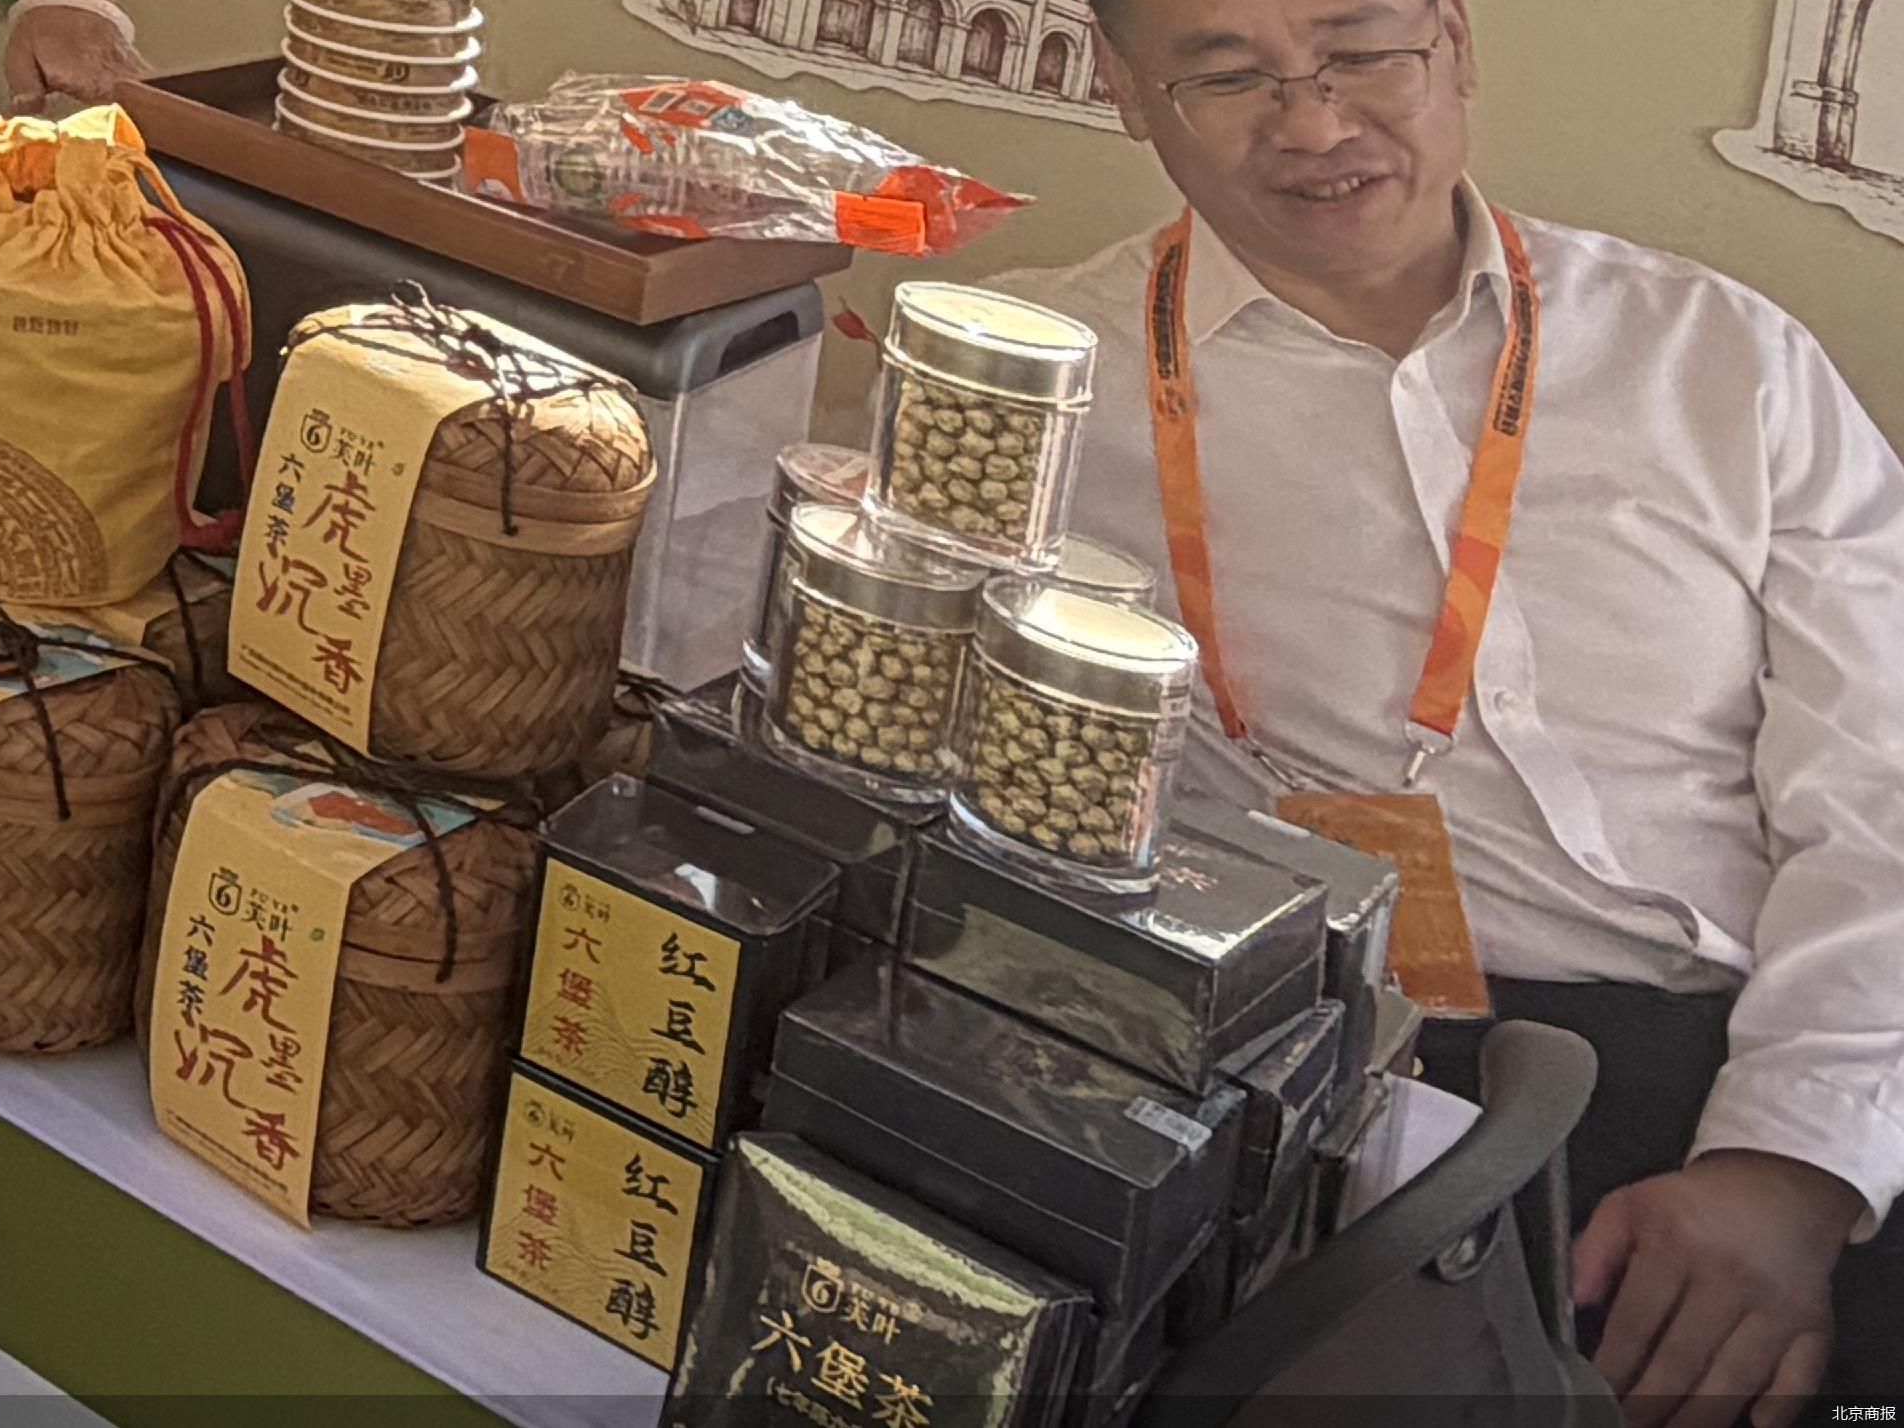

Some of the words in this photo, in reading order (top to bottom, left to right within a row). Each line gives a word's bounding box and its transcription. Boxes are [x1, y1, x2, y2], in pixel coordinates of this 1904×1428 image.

[550, 925, 603, 1057] 六堡茶
[642, 931, 717, 1120] 红豆醇
[516, 1140, 567, 1274] 六堡茶
[604, 1153, 679, 1341] 红豆醇
[750, 1309, 935, 1428] 六堡茶
